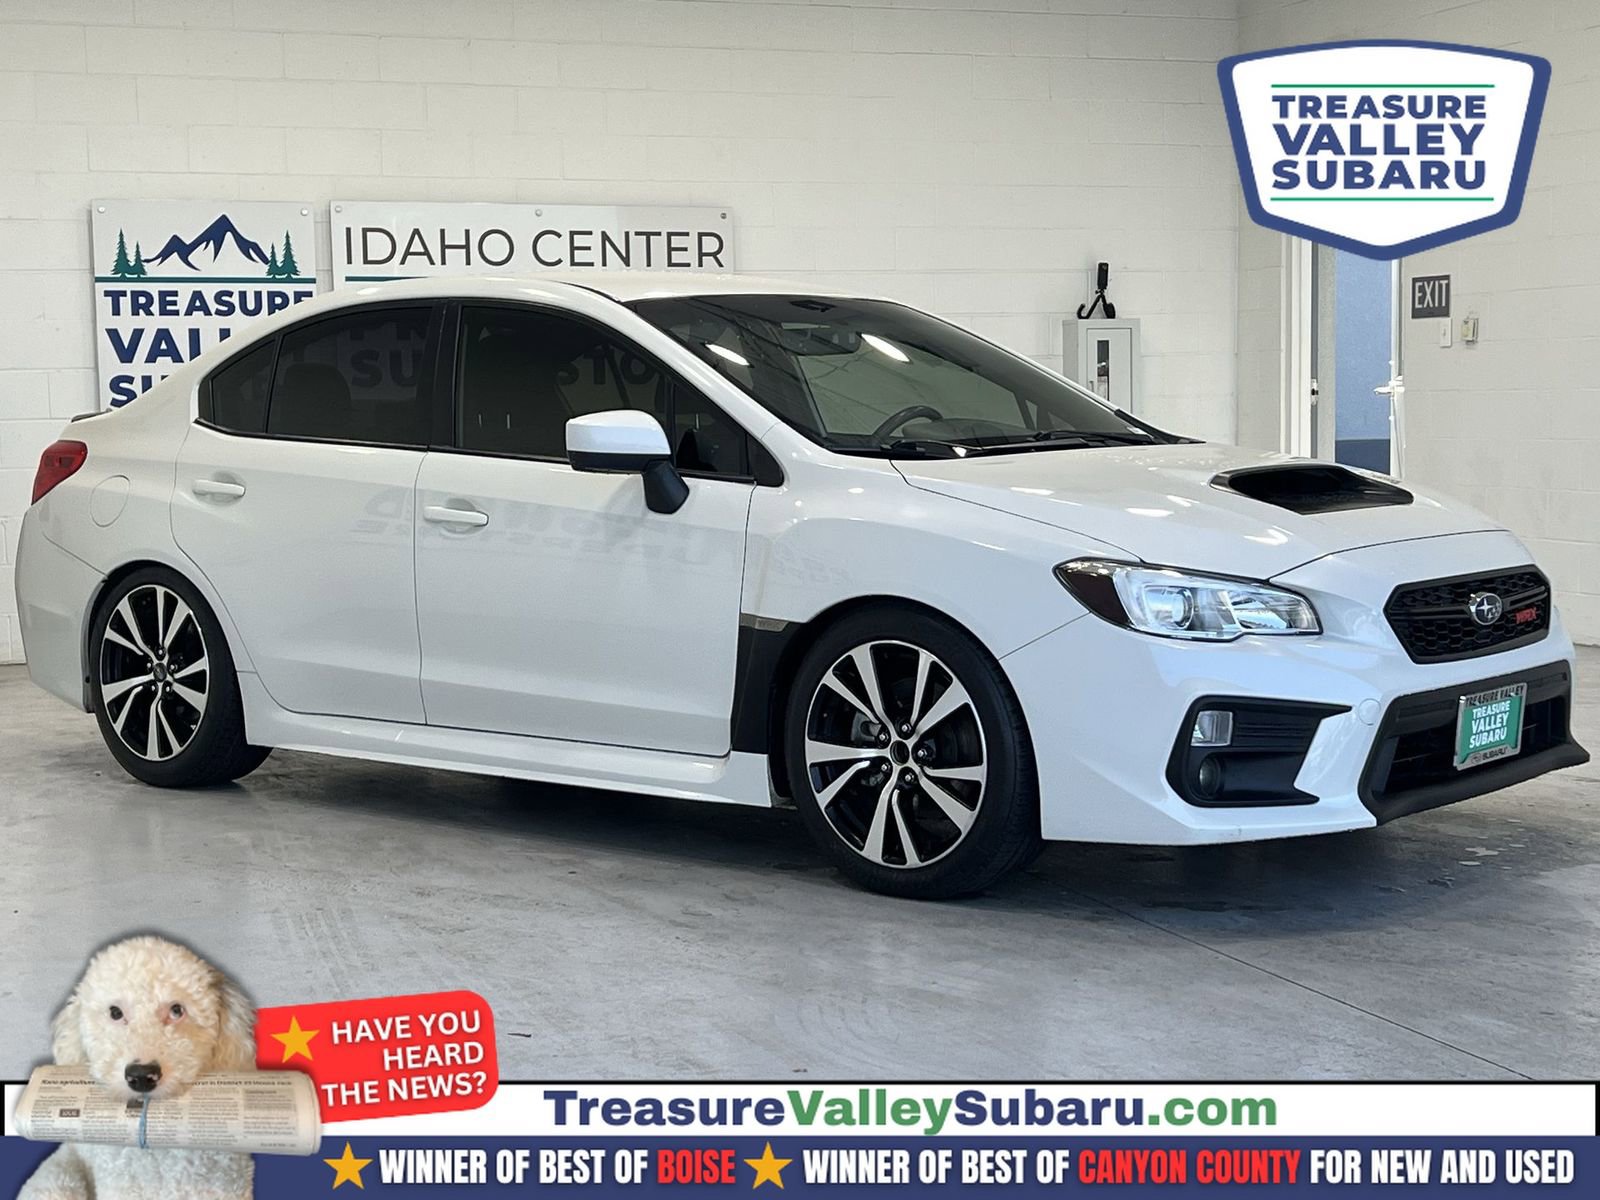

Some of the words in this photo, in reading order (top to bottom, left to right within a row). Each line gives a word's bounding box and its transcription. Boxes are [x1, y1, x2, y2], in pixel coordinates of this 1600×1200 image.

[345, 227, 515, 267] IDAHO
[532, 229, 724, 268] CENTER
[1415, 280, 1449, 308] EXIT
[1472, 700, 1511, 720] TREASURE
[1472, 712, 1510, 734] VALLEY
[1469, 727, 1508, 749] SUBARU
